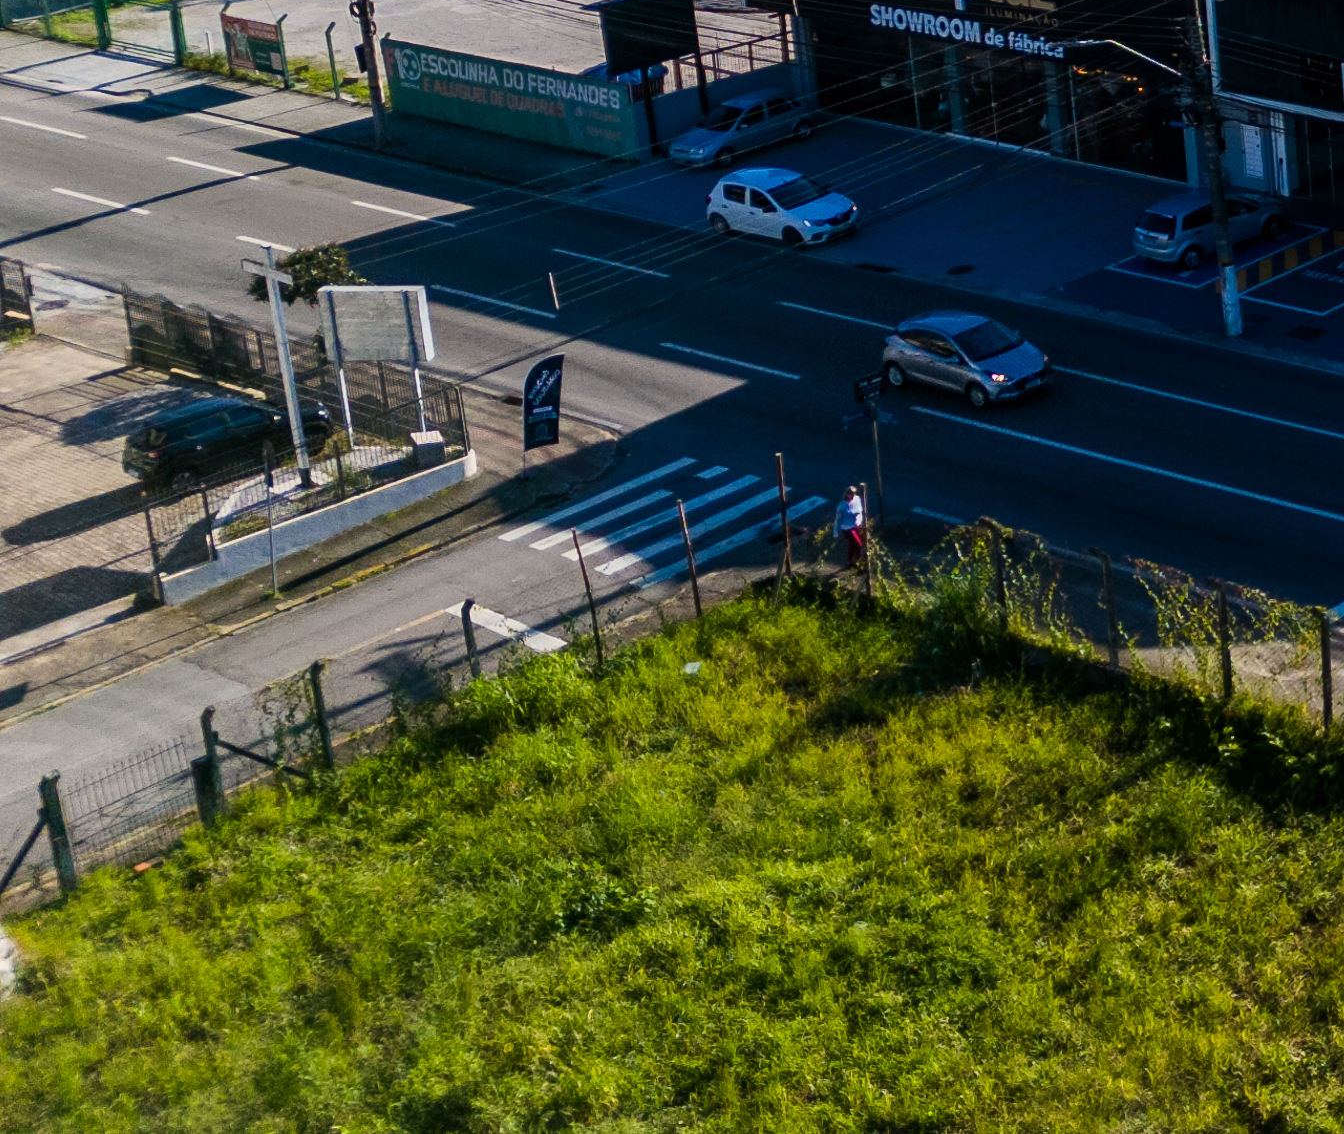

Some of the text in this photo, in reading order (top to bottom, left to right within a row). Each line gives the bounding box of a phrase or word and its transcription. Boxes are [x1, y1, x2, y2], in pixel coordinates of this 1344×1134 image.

[870, 4, 981, 43] SHOWROOM
[984, 27, 1004, 48] de
[420, 52, 620, 109] ESCOLINHA DO FERNANDES
